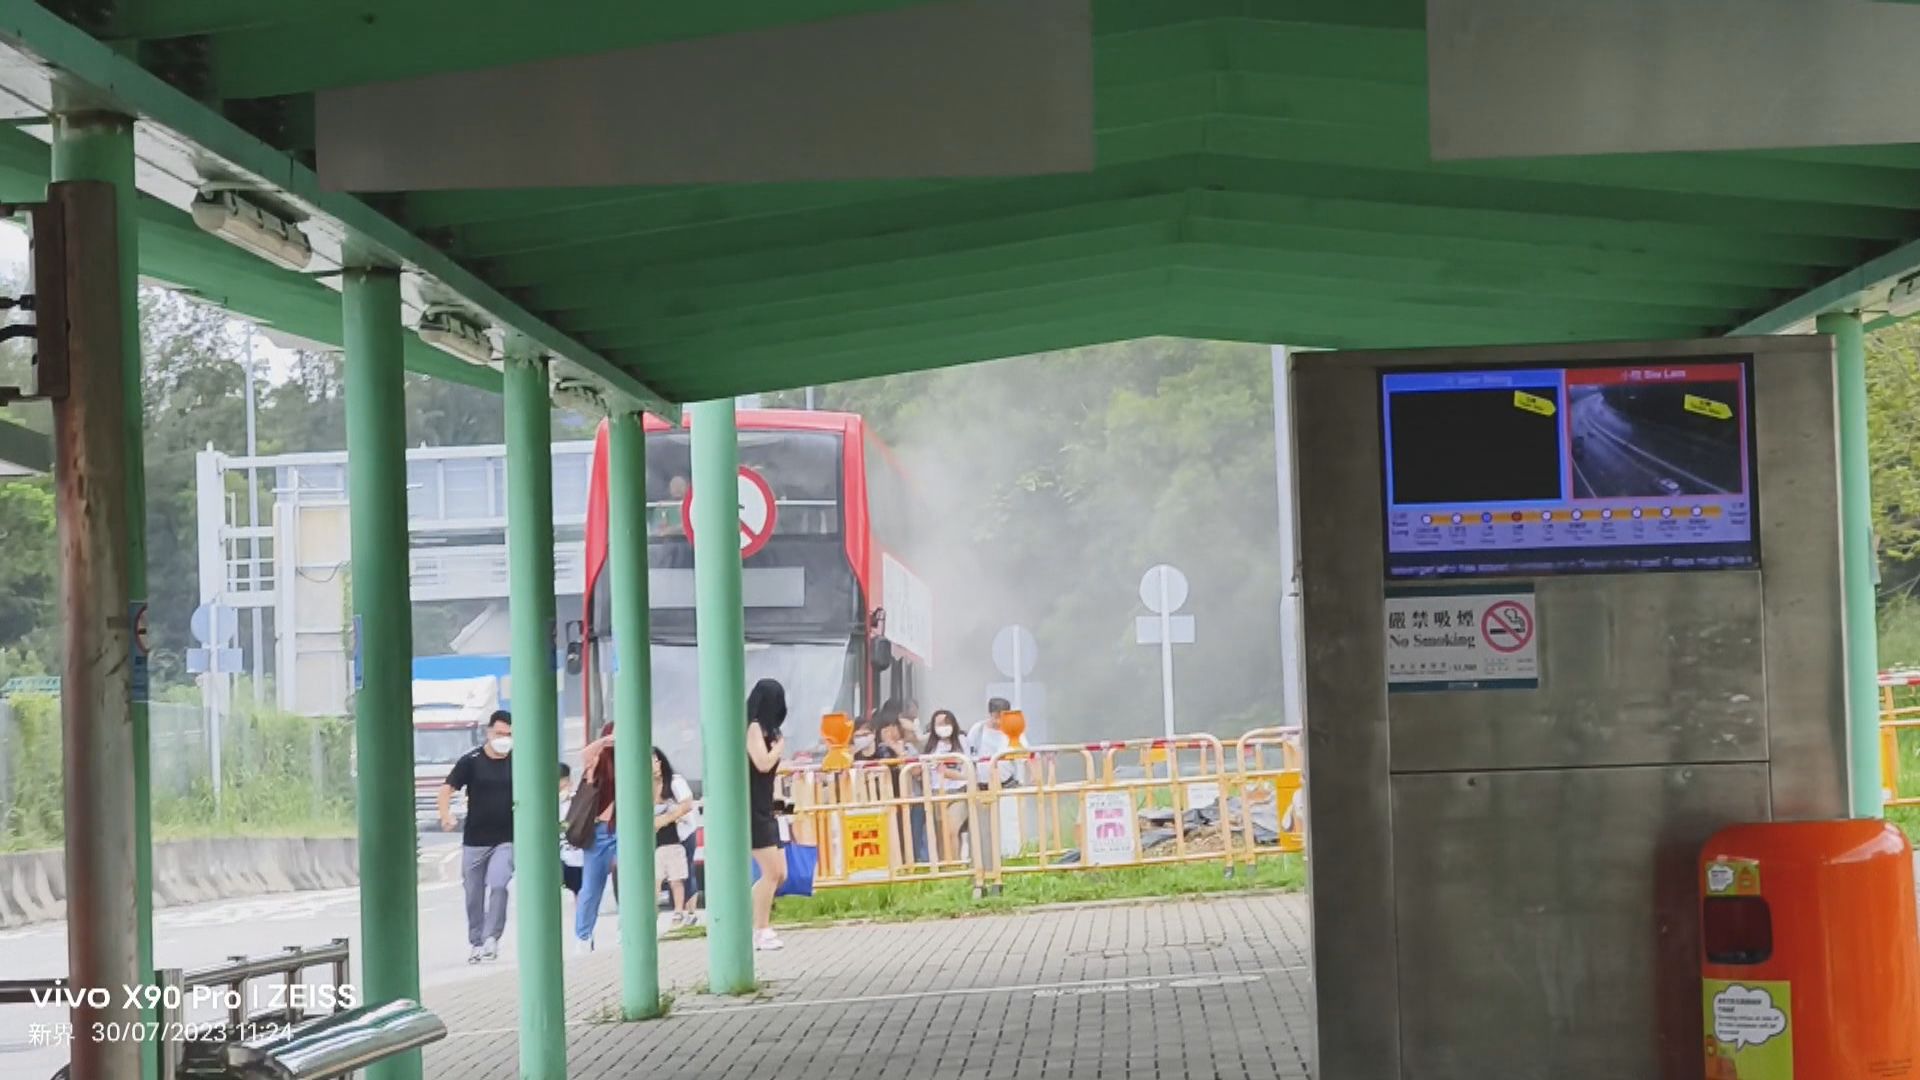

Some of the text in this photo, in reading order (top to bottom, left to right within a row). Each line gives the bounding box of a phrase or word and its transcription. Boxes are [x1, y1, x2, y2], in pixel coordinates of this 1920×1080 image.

[1389, 609, 1474, 629] 嚴禁吸煙
[1390, 632, 1476, 649] No Smoking
